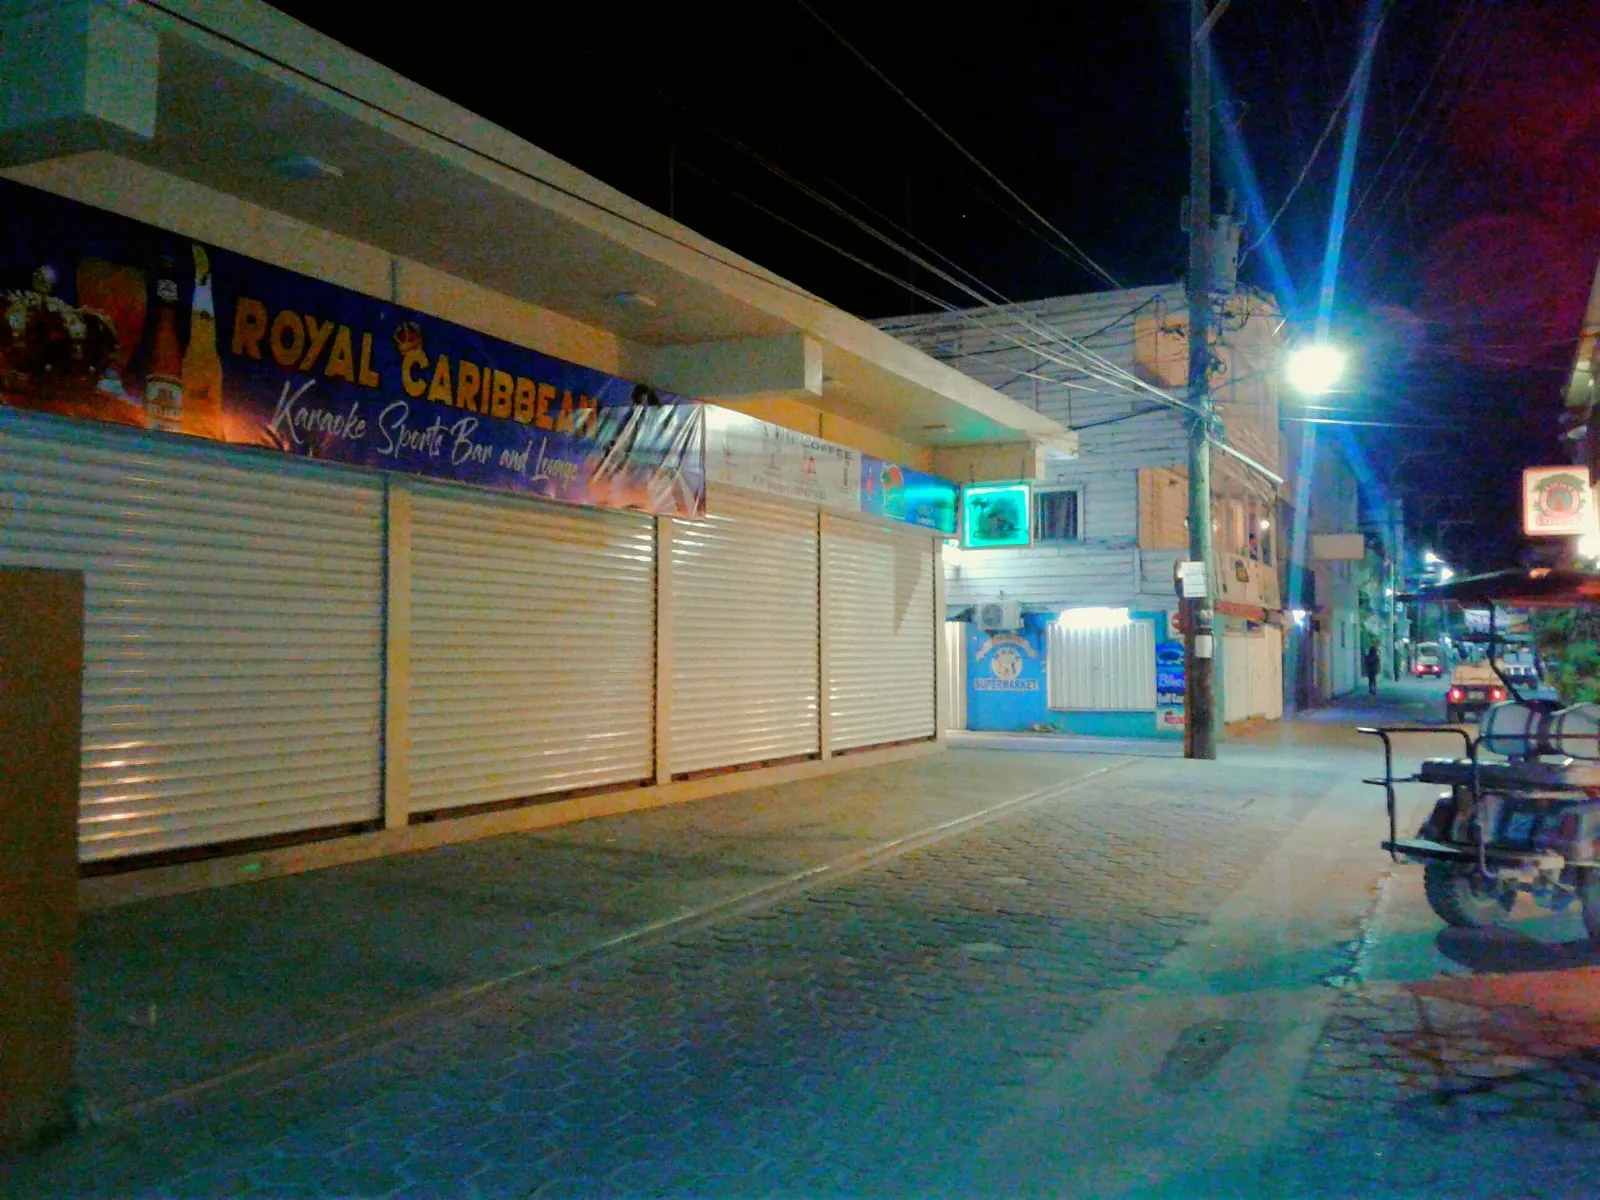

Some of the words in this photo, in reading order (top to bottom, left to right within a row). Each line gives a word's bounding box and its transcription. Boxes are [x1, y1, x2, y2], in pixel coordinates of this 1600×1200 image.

[231, 296, 381, 388] ROYAL
[400, 349, 598, 440] CARIBBEAN
[266, 378, 367, 445] Karaoke
[376, 400, 449, 460] Sports
[450, 417, 494, 466] Bar
[499, 437, 530, 473] and
[531, 437, 580, 487] Lounge
[974, 678, 1038, 690] SUPERMARKET
